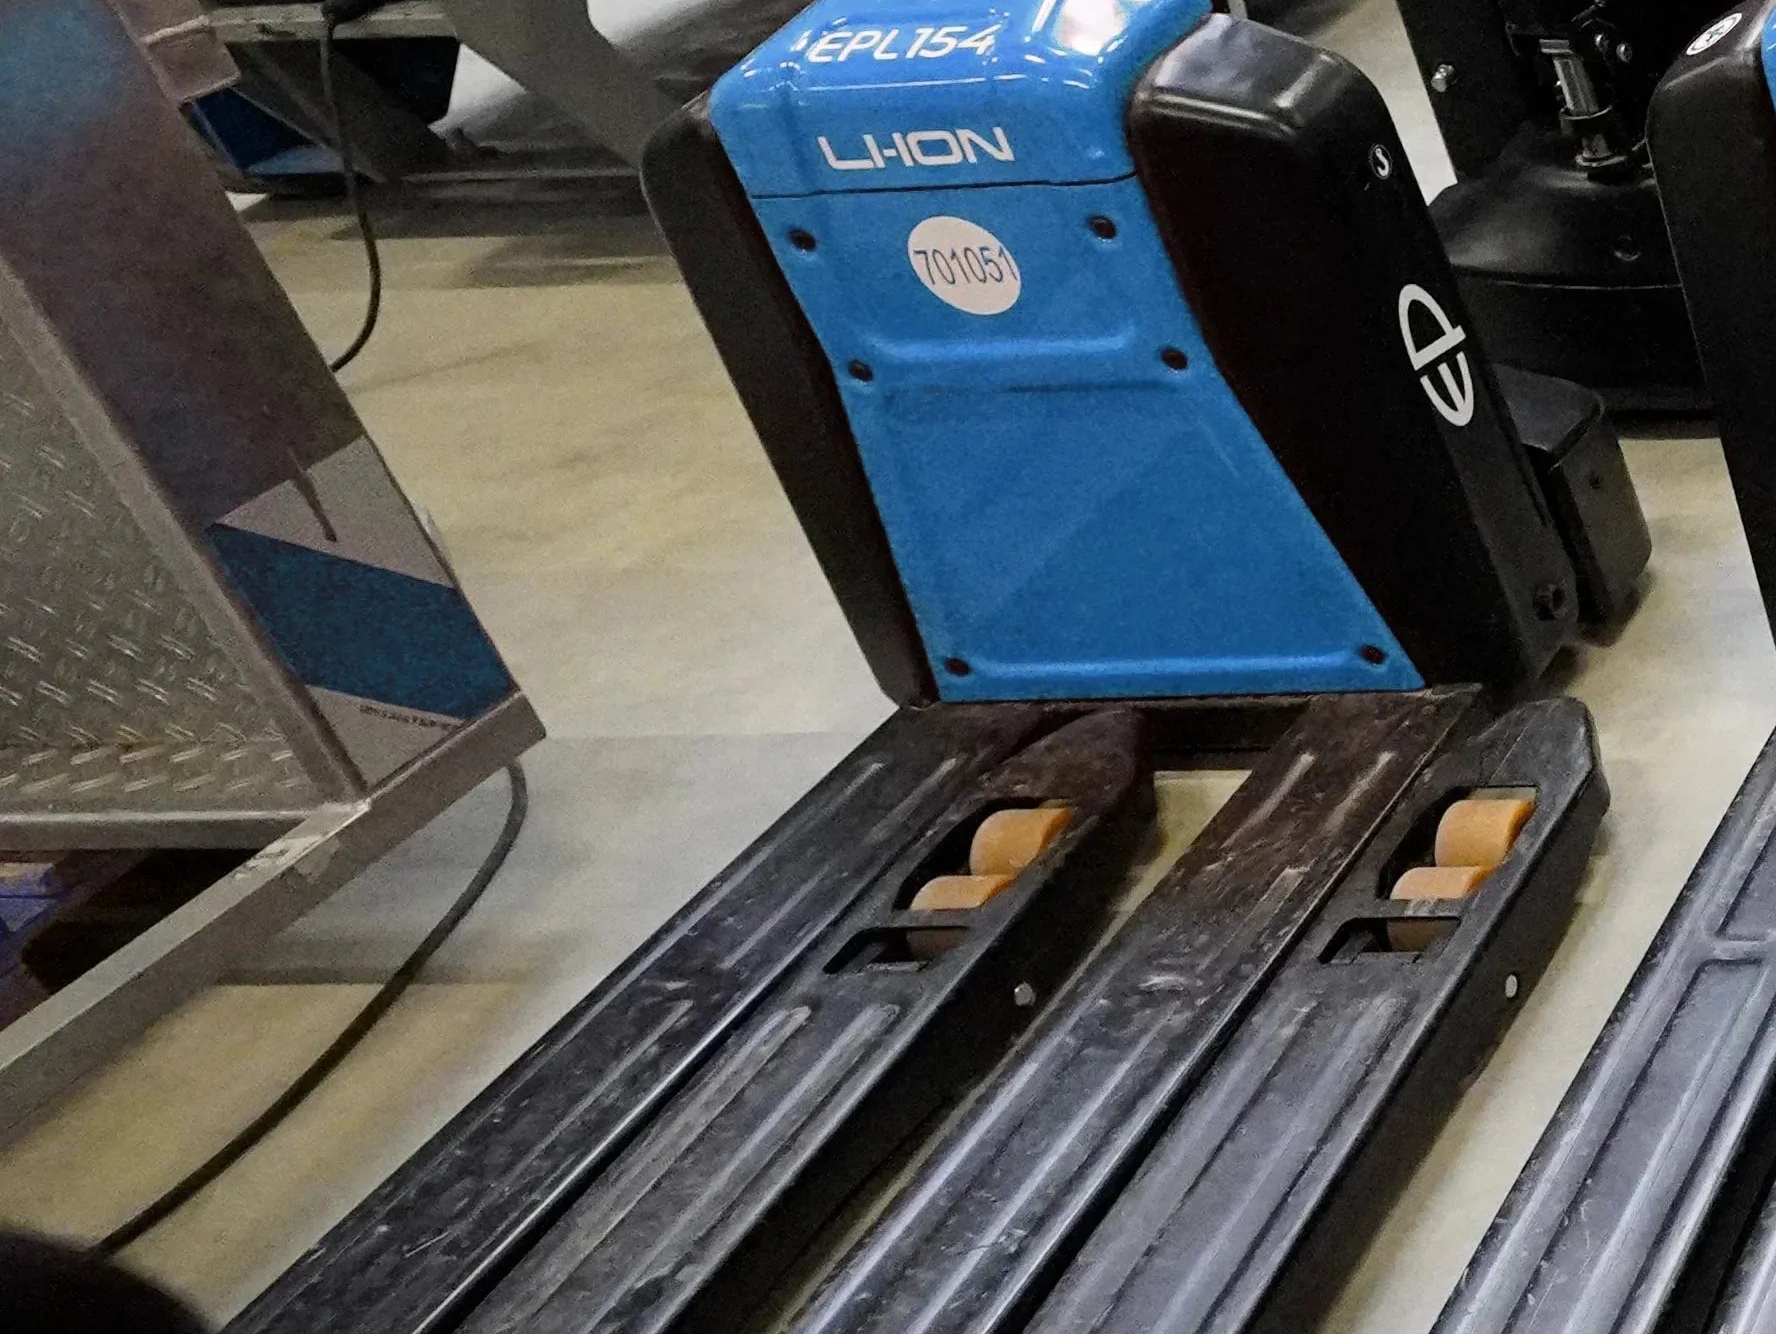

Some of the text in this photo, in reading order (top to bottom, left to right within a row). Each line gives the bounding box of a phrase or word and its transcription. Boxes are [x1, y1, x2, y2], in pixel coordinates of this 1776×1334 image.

[807, 24, 1002, 63] EPL154
[817, 126, 1016, 170] LI-ION
[913, 245, 1018, 286] 701051
